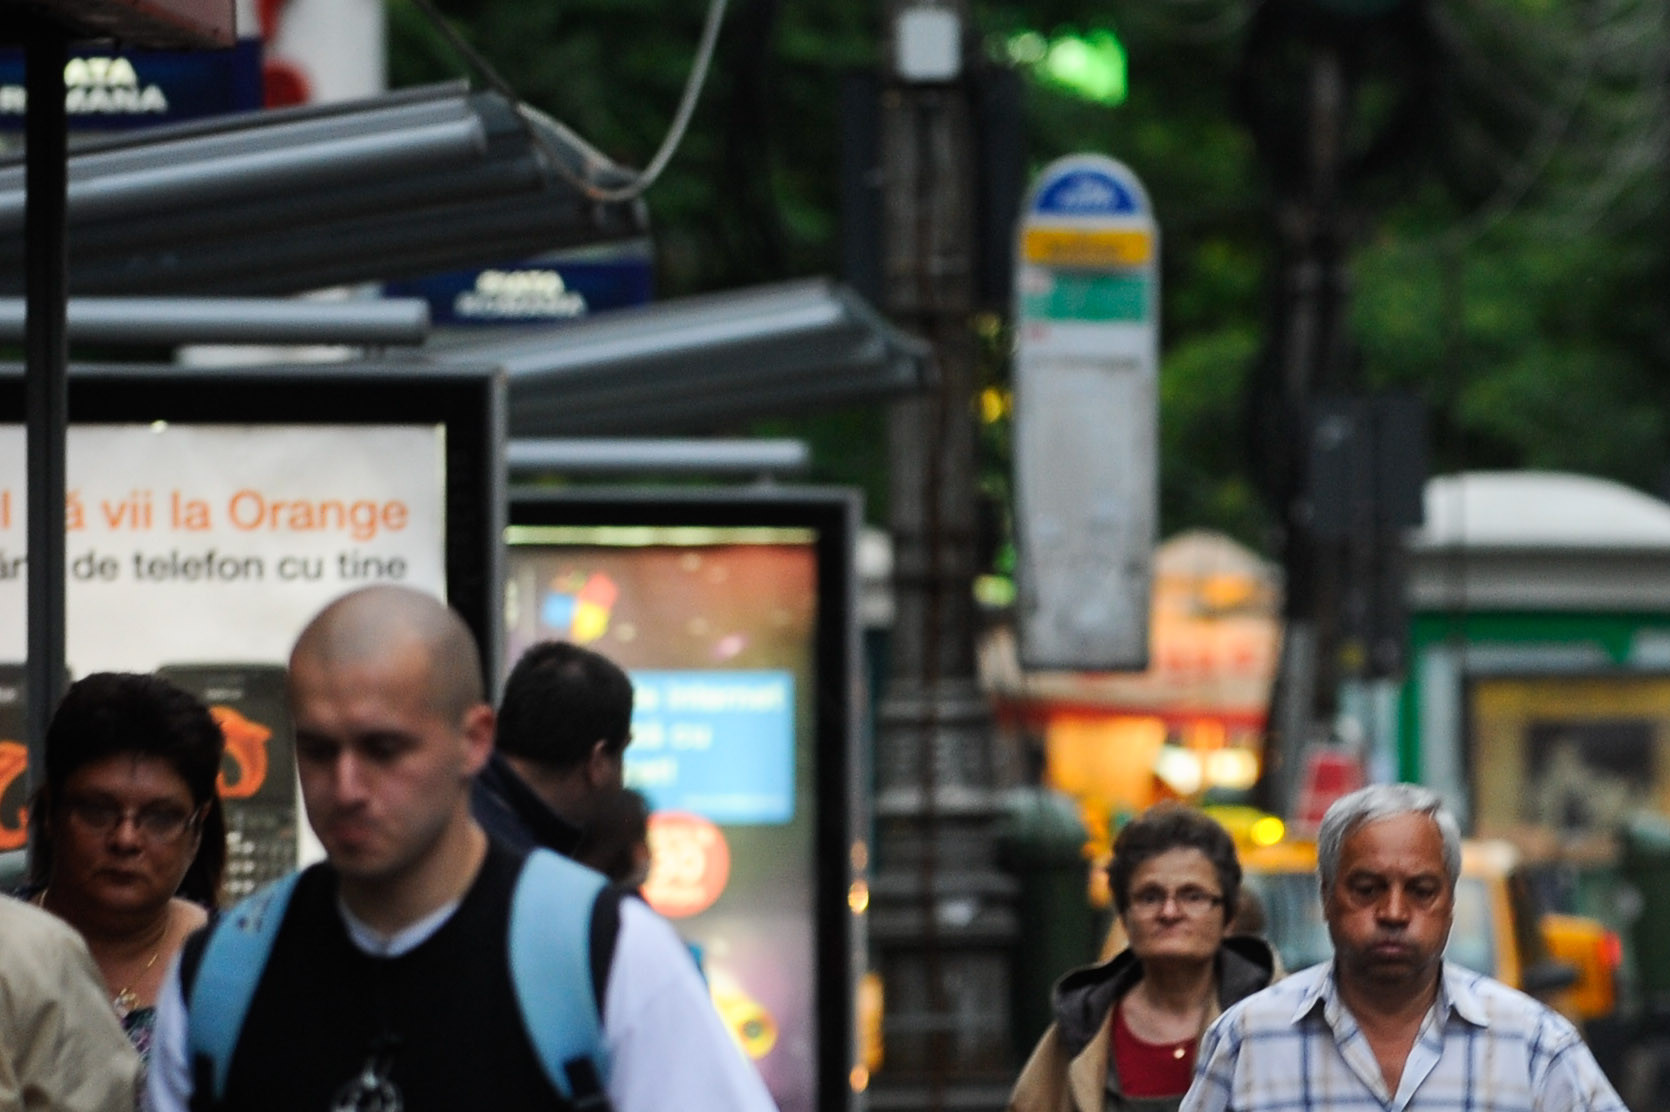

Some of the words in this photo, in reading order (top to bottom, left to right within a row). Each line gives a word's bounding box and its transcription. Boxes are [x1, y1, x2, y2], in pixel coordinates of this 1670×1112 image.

[101, 489, 151, 530] vii
[171, 489, 210, 531] la
[228, 489, 408, 541] Orange
[73, 552, 118, 580] de
[134, 550, 263, 580] telefon
[278, 556, 322, 580] cu
[339, 550, 407, 580] tine
